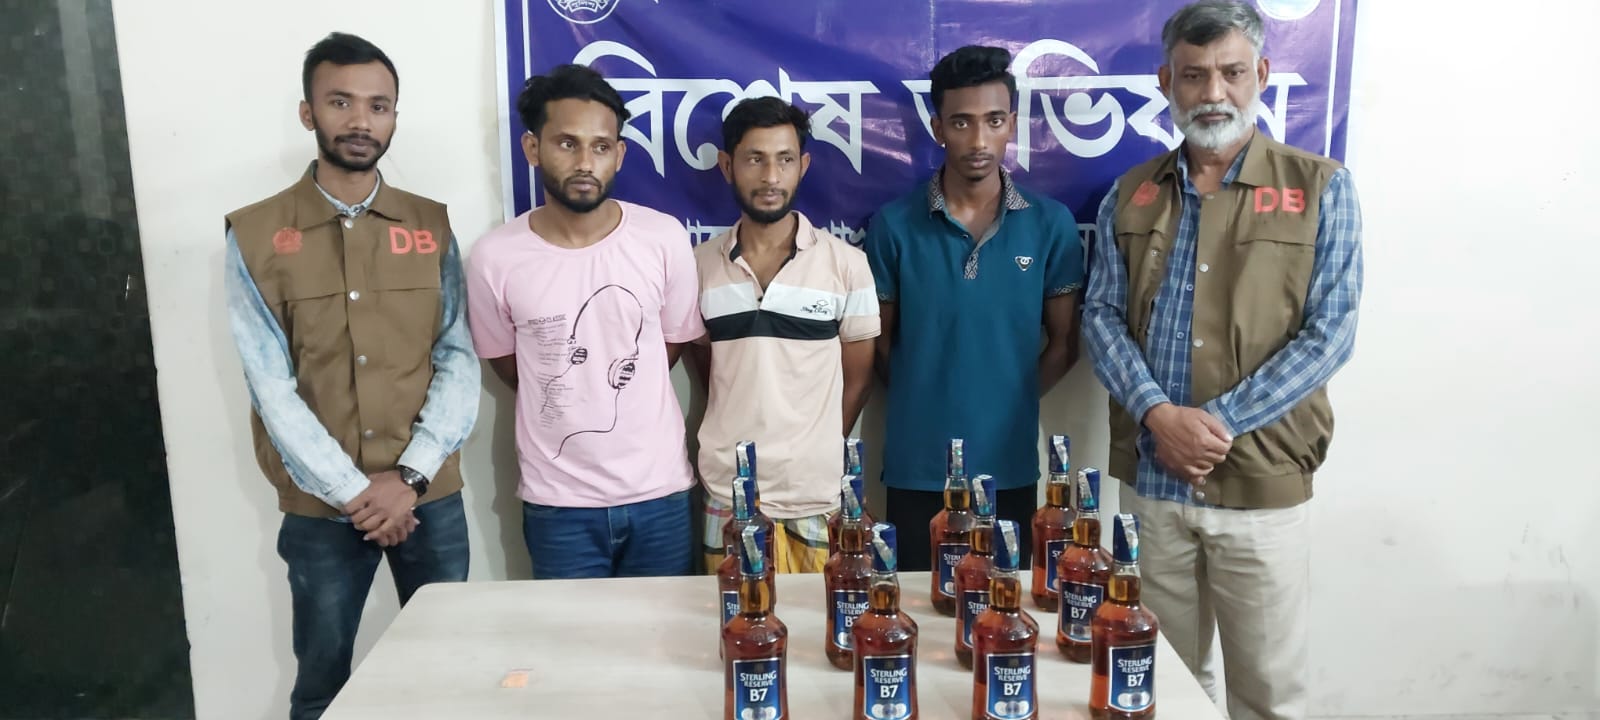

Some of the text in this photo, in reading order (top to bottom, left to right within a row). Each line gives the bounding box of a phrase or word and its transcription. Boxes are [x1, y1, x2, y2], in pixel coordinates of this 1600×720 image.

[1254, 186, 1306, 213] DB
[389, 225, 438, 255] DB
[1064, 590, 1097, 604] STERLING
[836, 600, 870, 610] STERLING
[1071, 606, 1087, 620] B7
[1117, 656, 1153, 668] STERLING
[870, 667, 908, 678] STERLING
[993, 664, 1031, 676] STERLING
[1121, 664, 1150, 674] RESERVE
[740, 670, 777, 682] STERLING
[998, 674, 1028, 682] RESERVE
[1127, 673, 1145, 687] B7
[743, 680, 774, 688] RESERVE
[1004, 682, 1022, 696] B7
[749, 688, 768, 702] B7
[880, 685, 899, 698] B7
